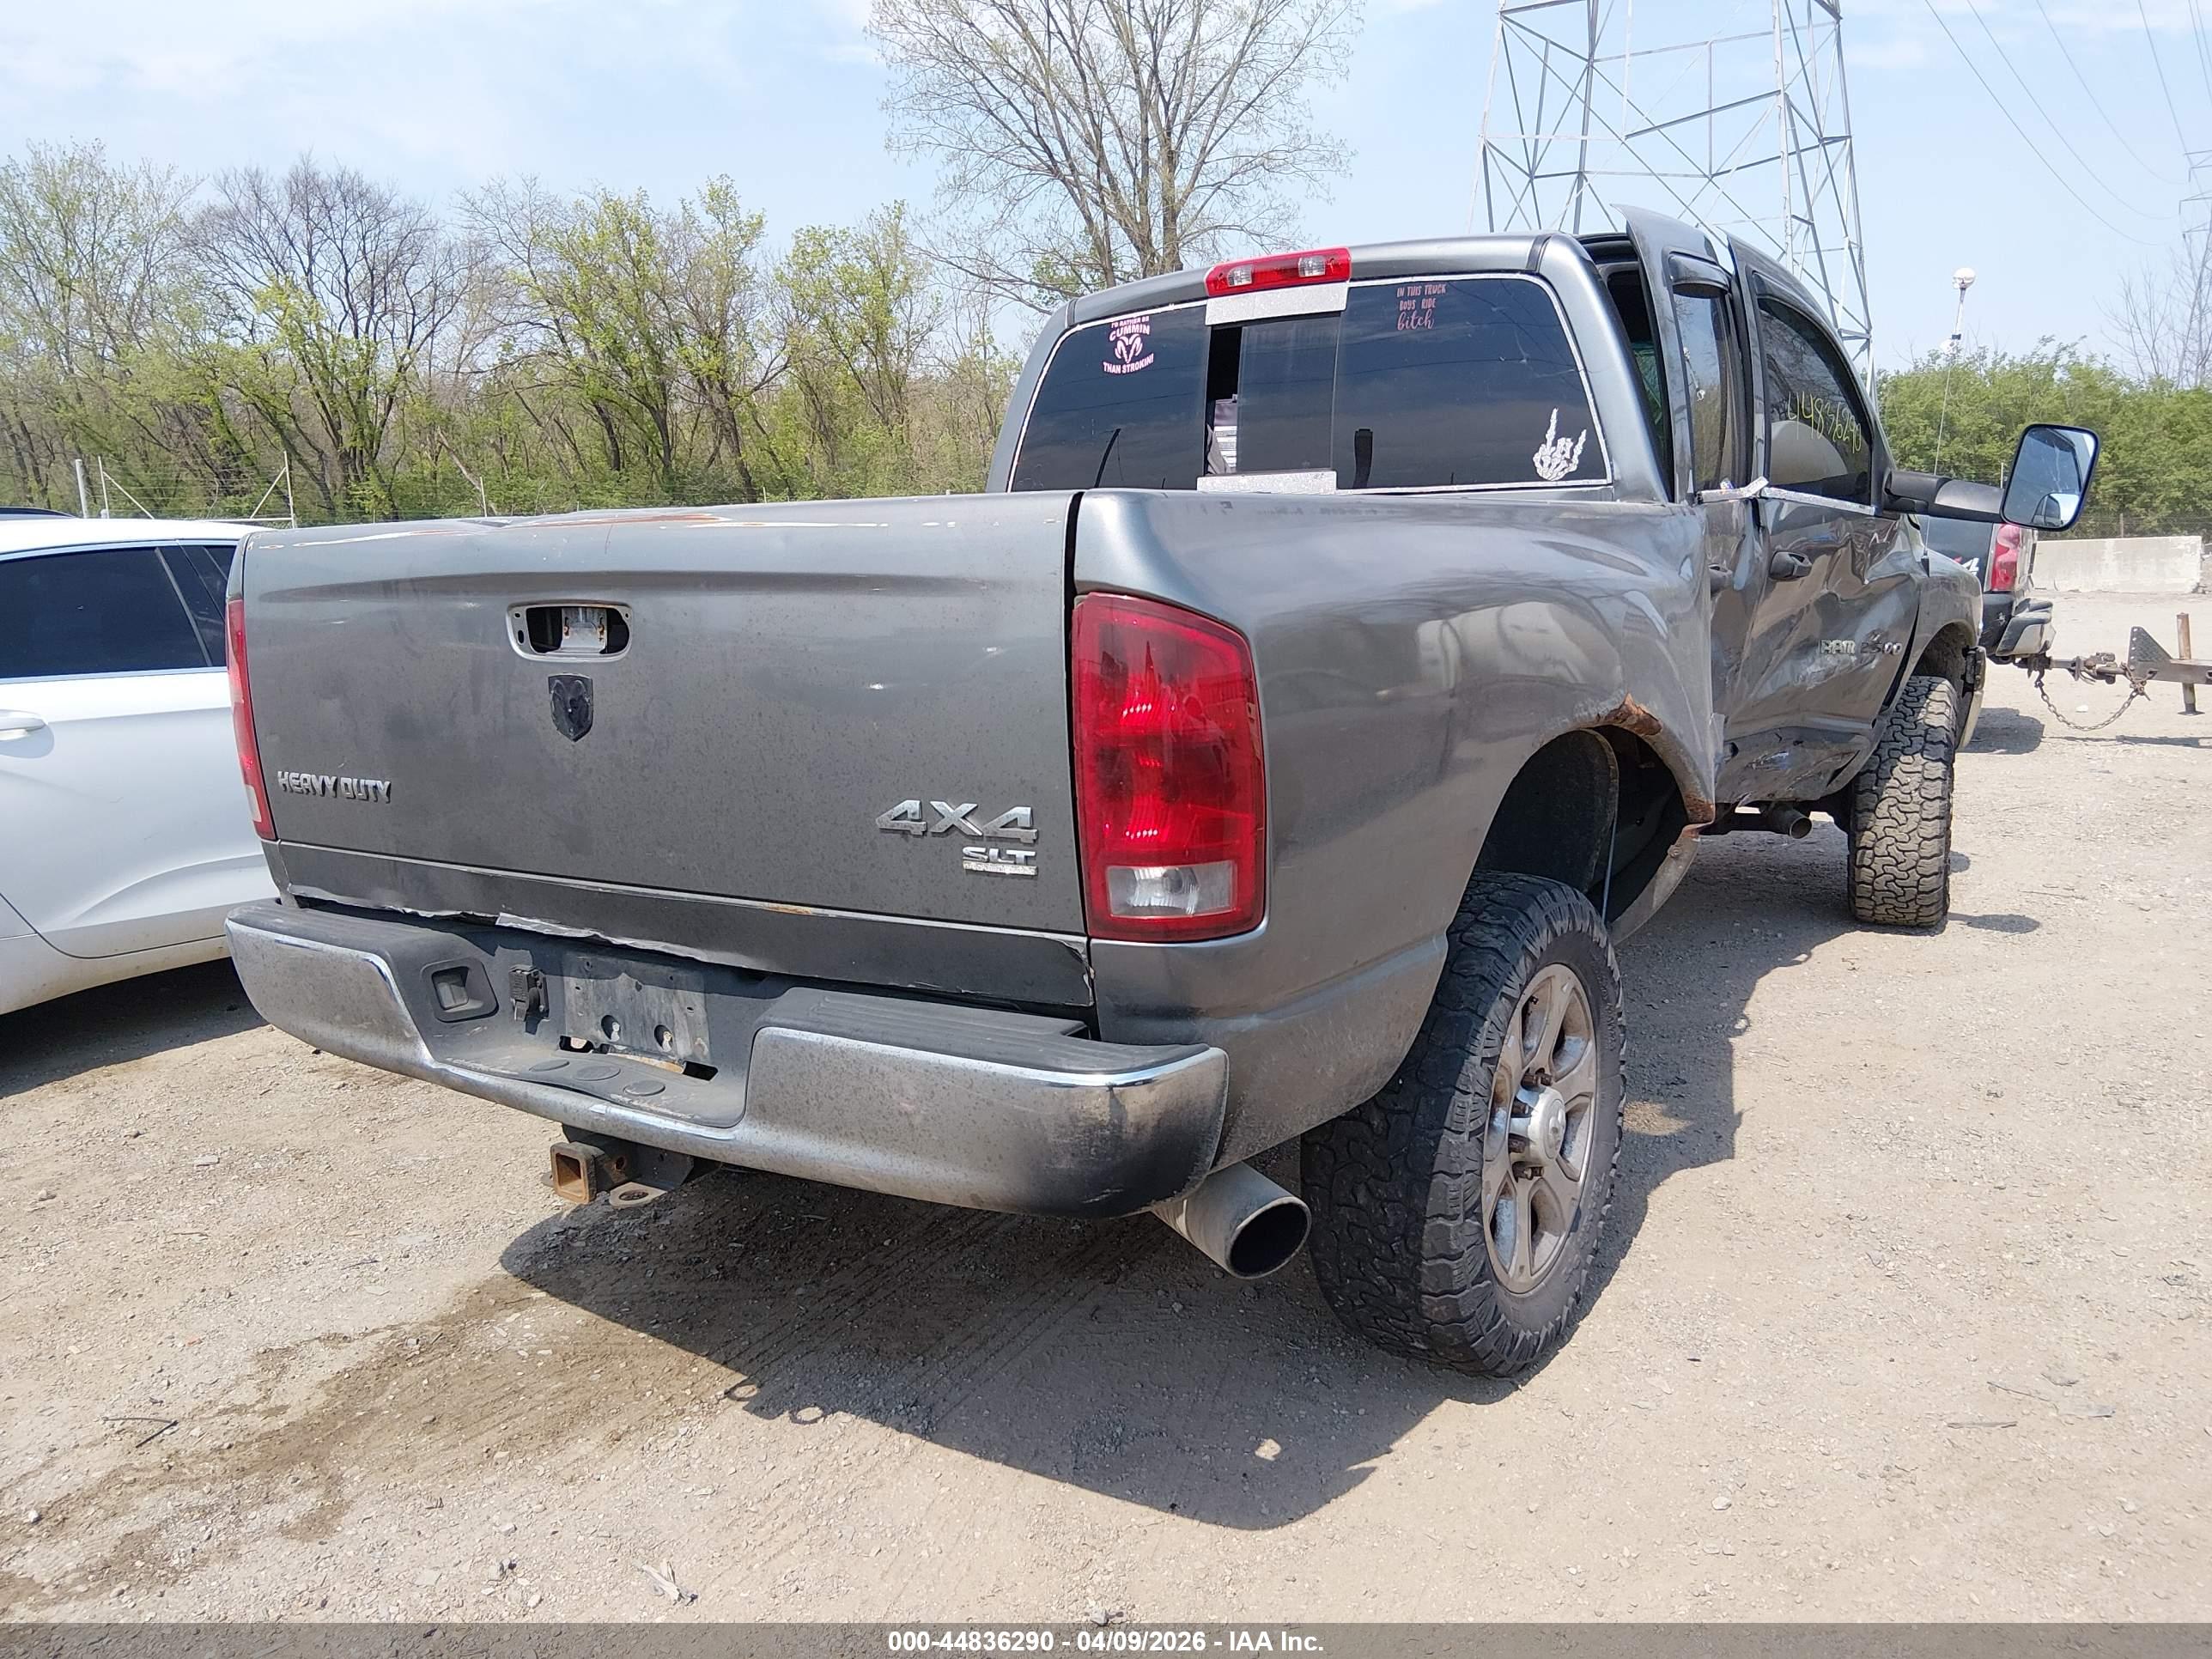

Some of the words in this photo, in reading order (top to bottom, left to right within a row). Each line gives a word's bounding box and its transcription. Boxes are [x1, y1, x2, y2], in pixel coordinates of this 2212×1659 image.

[1396, 288, 1404, 298] IN
[1407, 285, 1422, 296] THIS
[1424, 283, 1447, 295] TRUCK
[1399, 299, 1416, 312] BOYS
[1421, 297, 1437, 310] RIDE
[1119, 317, 1141, 327] RATHER
[1397, 308, 1435, 331] bitch
[1109, 324, 1151, 342] CUMMIN
[1103, 362, 1121, 374] THAN
[1787, 391, 1862, 454] 44836290
[1820, 640, 1856, 654] RAM
[1860, 641, 1903, 655] 2500
[277, 770, 337, 799] HEAVY
[340, 776, 392, 805] DUTY
[875, 799, 1039, 845] 4X4
[962, 846, 1036, 865] SLT
